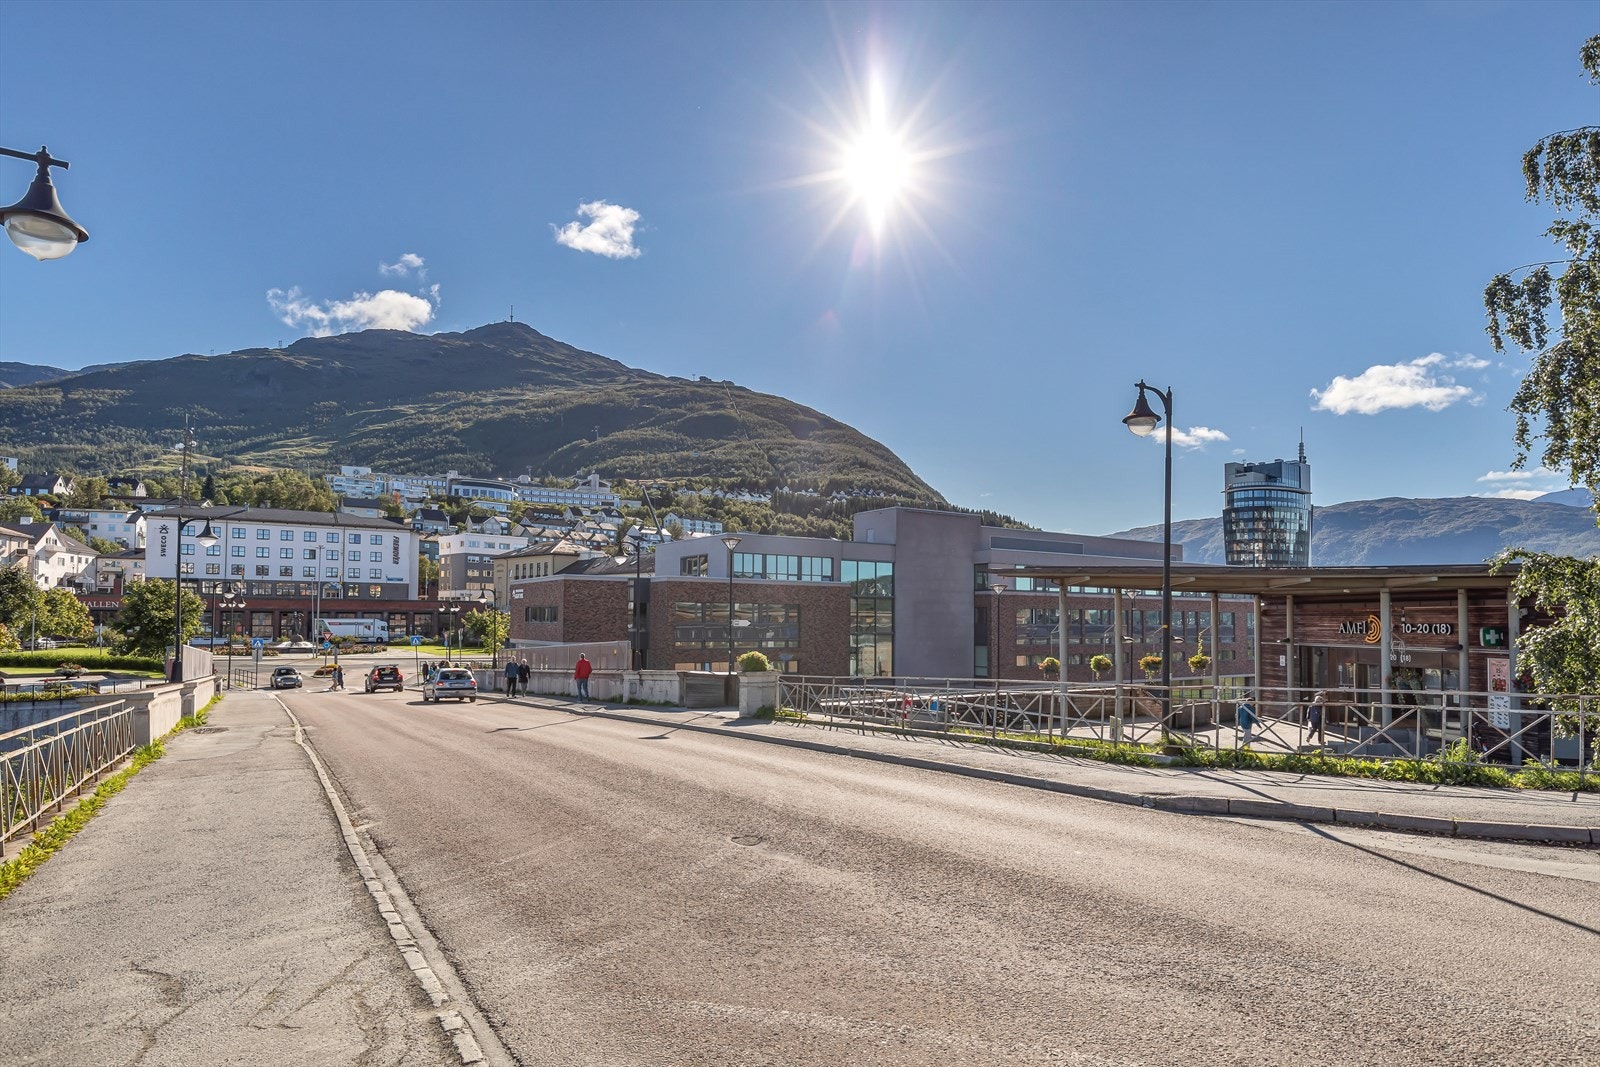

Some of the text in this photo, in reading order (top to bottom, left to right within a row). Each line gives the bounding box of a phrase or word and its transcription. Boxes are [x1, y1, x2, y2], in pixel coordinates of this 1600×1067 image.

[1338, 620, 1366, 635] AMFI
[1401, 623, 1452, 636] 10-20 (18)
